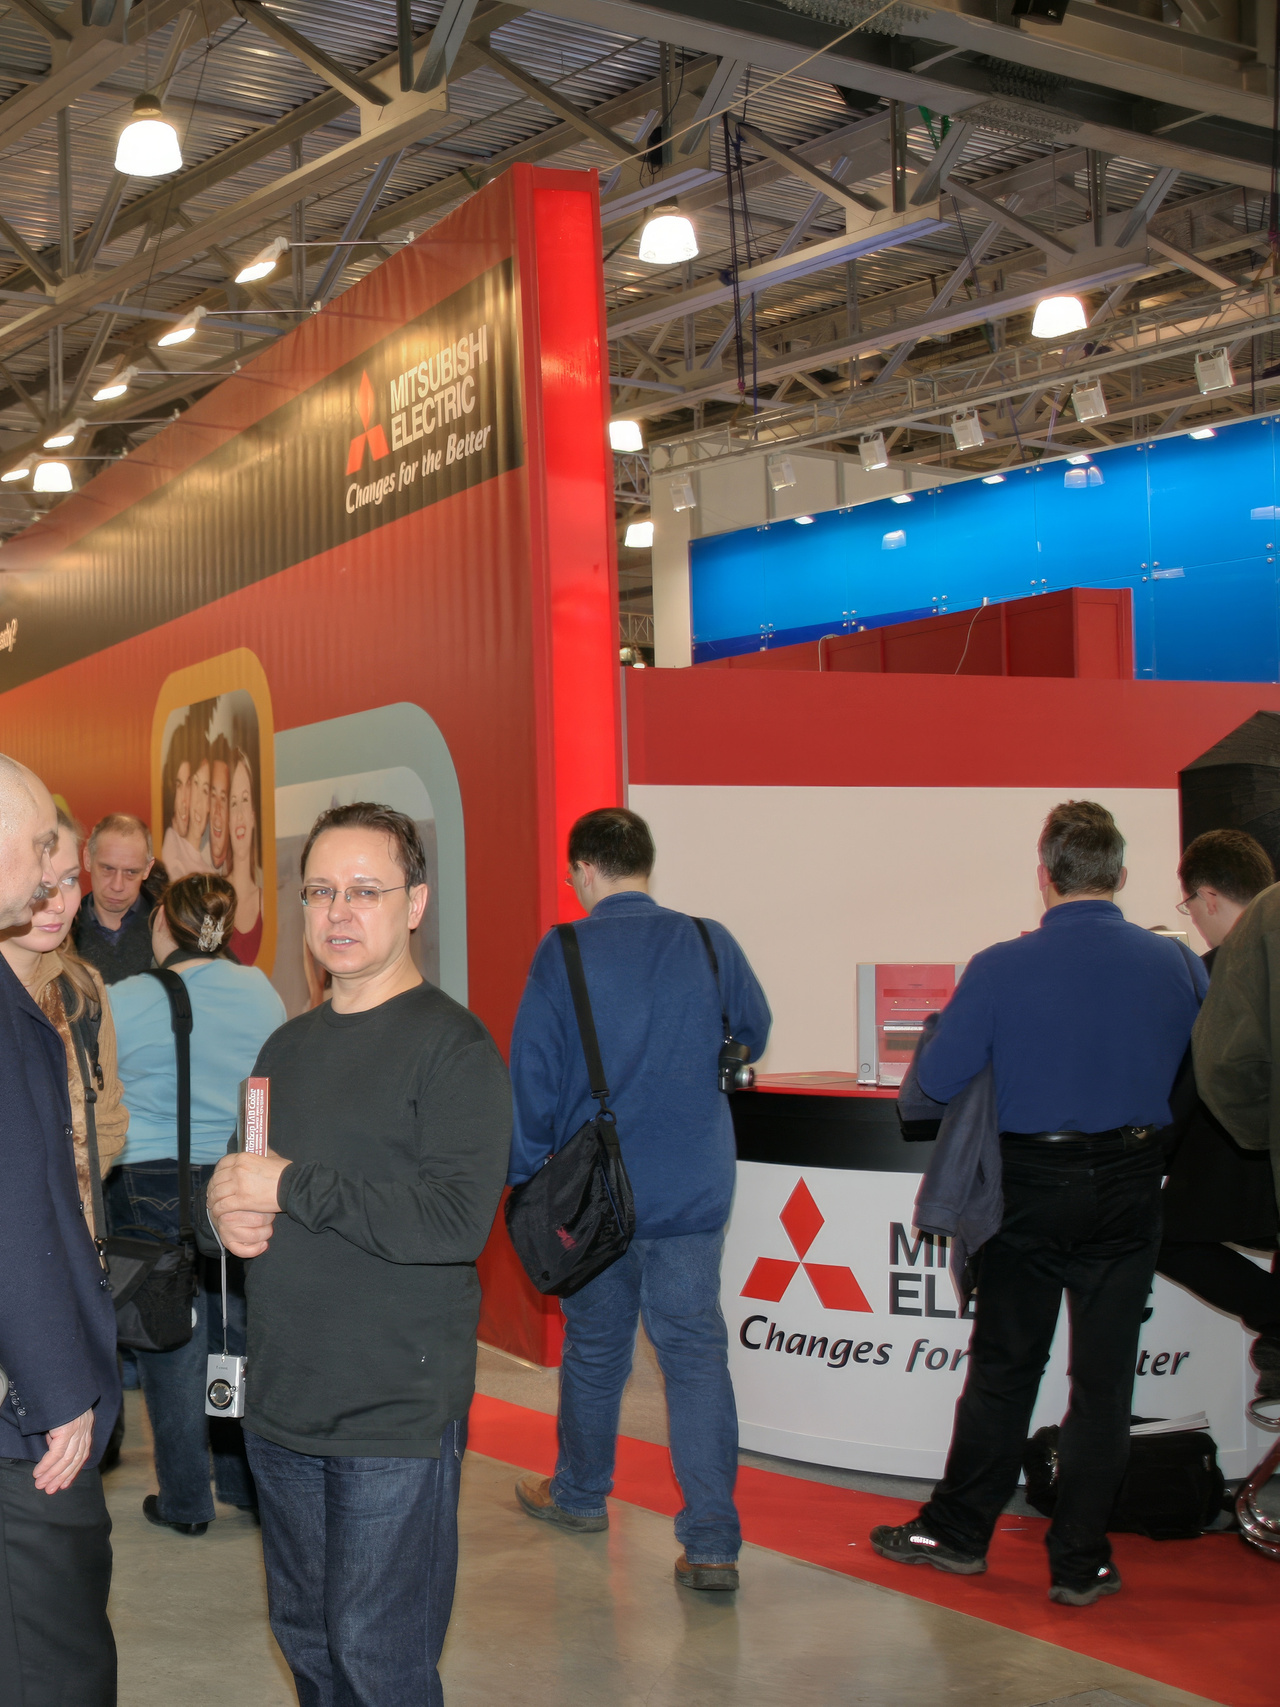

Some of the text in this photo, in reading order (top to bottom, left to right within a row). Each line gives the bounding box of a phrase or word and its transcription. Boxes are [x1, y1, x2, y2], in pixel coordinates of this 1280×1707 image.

[390, 324, 488, 414] MITSUBISHI
[391, 375, 476, 452] ELECTRIC
[345, 424, 492, 514] Changes for the Better
[739, 1314, 893, 1369] Changes
[905, 1338, 970, 1373] for
